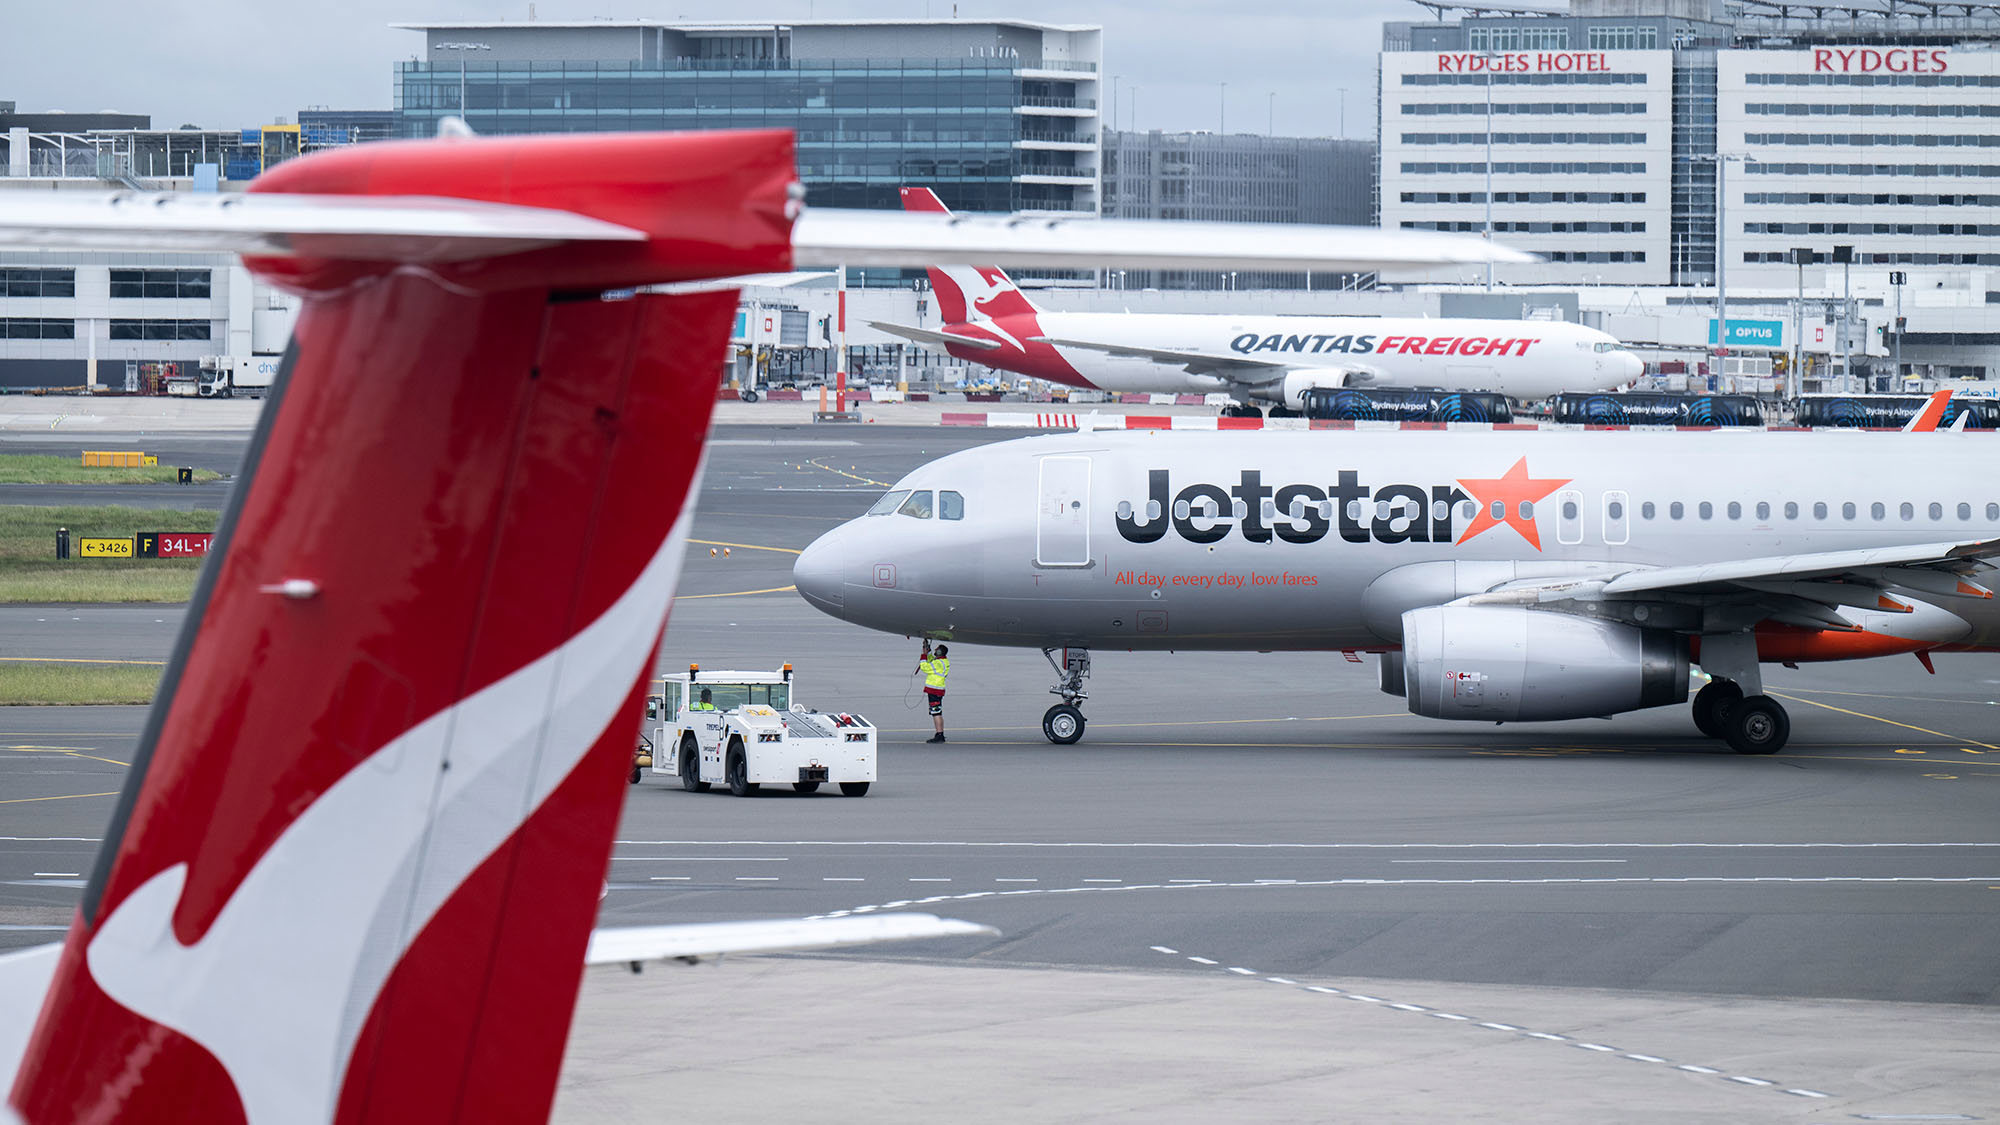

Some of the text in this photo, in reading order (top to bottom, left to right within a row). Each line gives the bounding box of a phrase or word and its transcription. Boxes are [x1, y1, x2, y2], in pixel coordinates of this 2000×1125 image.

[1438, 53, 1611, 73] RYDGES HOTEL
[1815, 49, 1947, 72] RYDGES
[1735, 327, 1773, 339] OPTUS
[1230, 333, 1541, 357] QANTAS FREIGHT
[1371, 401, 1427, 411] Sydney Airport
[1622, 405, 1678, 415] Sydney Airport
[1866, 407, 1893, 417] Sydney
[1115, 469, 1474, 544] Jetstar
[98, 543, 128, 553] 3426
[143, 538, 153, 552] F
[1115, 571, 1318, 589] All day, every day, low fares
[1067, 659, 1086, 670] FT
